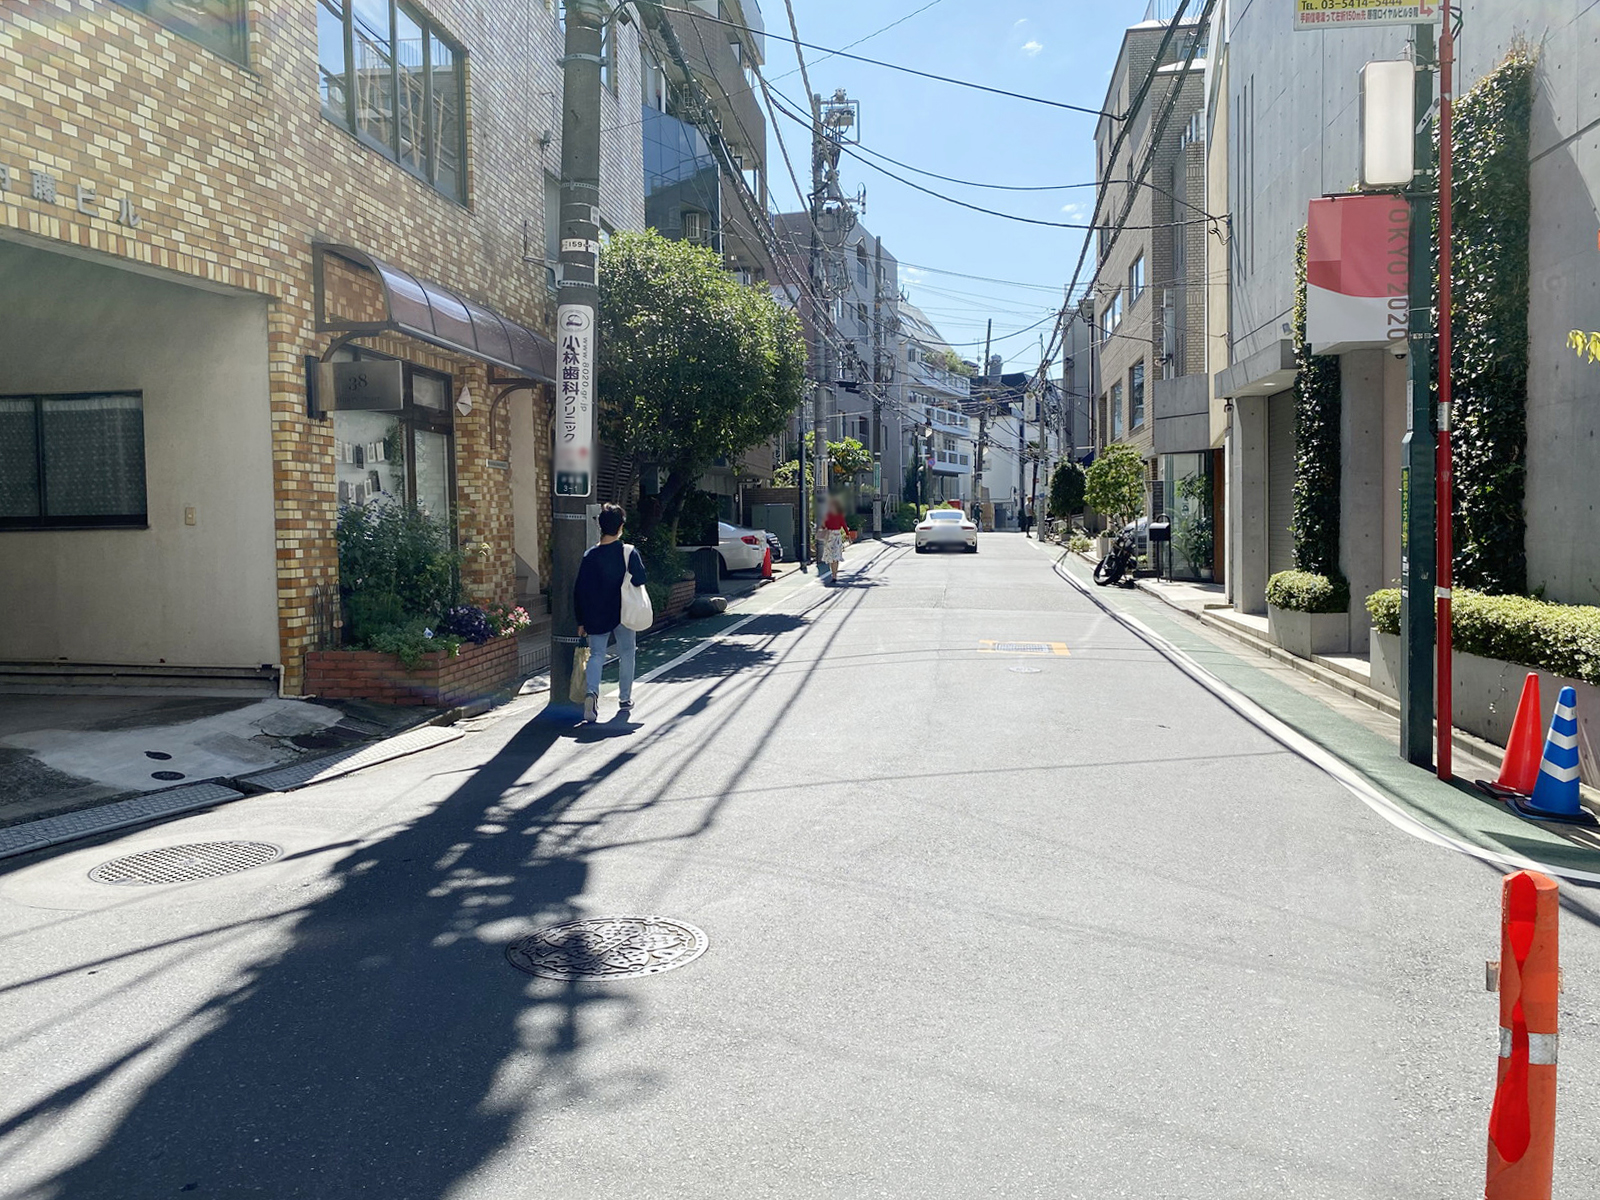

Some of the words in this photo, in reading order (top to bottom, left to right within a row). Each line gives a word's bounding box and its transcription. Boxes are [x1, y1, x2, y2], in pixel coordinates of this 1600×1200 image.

[1387, 282, 1409, 341] 2020
[349, 374, 367, 391] 38
[562, 335, 580, 442] 小林歯科クリニック
[581, 337, 589, 412] www.8020.gr.jp
